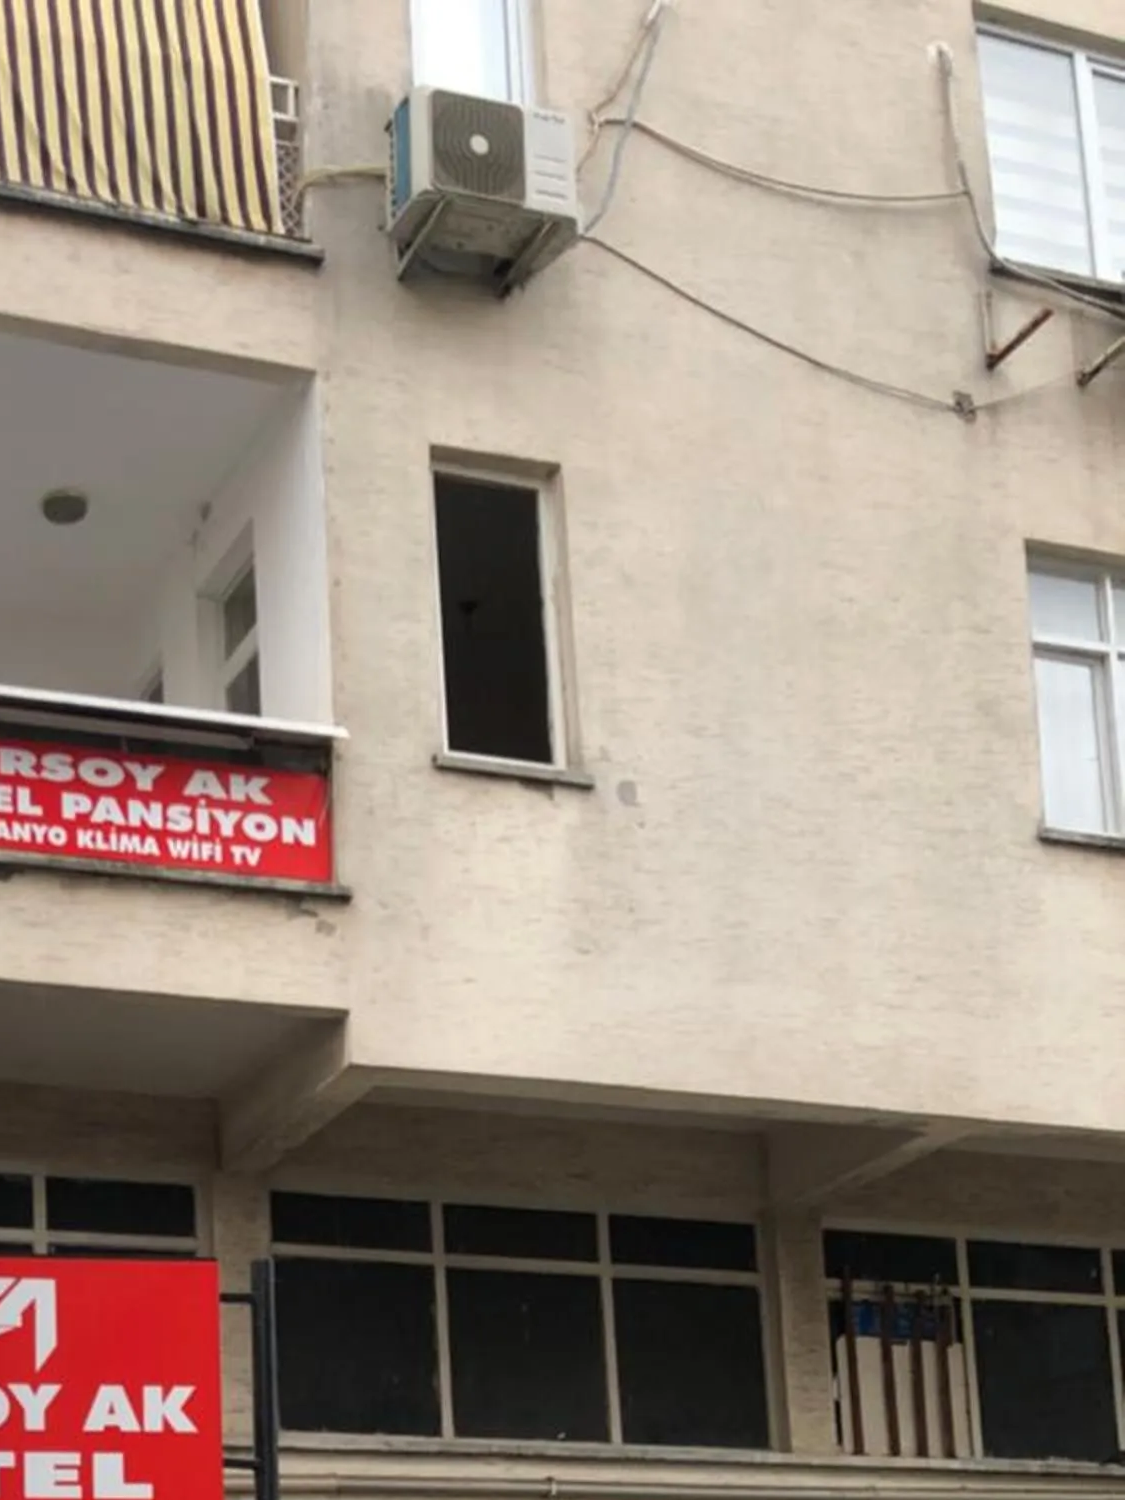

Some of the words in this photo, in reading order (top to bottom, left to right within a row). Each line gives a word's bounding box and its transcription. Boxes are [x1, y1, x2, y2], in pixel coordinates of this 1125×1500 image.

[183, 769, 273, 805] AK
[61, 790, 316, 846] PANSİYON
[77, 826, 161, 856] KLİMA
[167, 834, 223, 864] WİFİ
[229, 845, 263, 866] TV
[82, 1384, 199, 1434] AK
